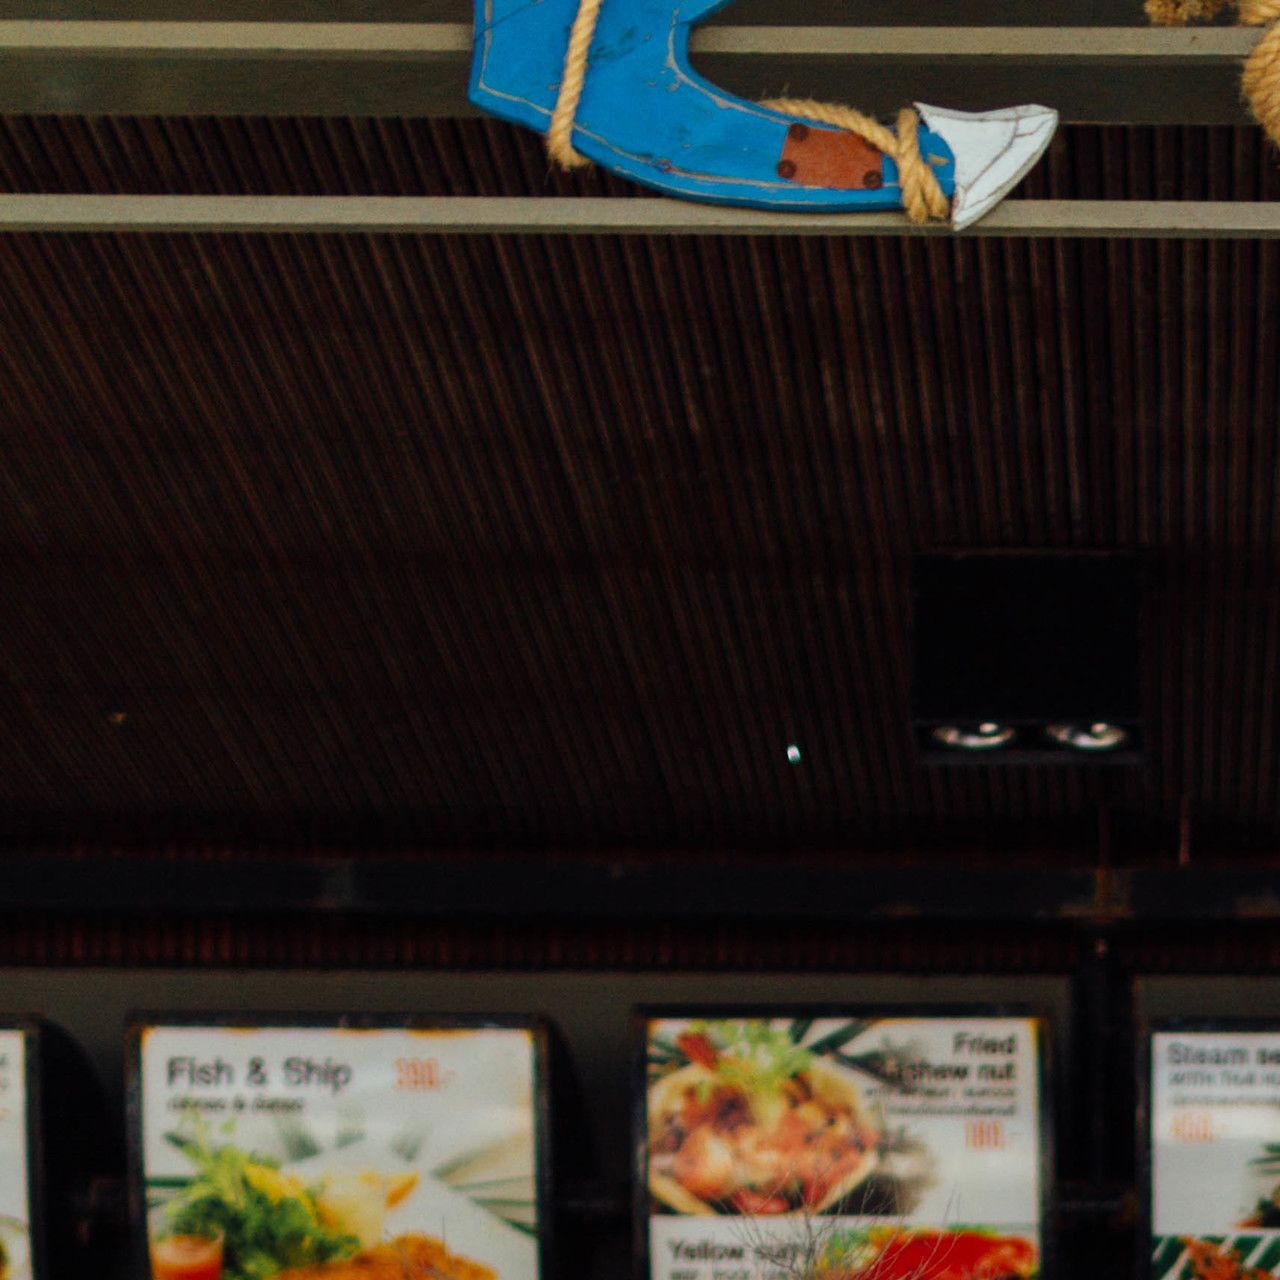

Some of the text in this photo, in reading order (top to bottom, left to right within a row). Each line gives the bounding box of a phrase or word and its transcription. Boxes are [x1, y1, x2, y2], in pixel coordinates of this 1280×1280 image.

[953, 1032, 1018, 1054] Fried
[1168, 1041, 1248, 1065] Steam
[167, 1056, 353, 1094] Fish & Ship
[976, 1060, 1017, 1081] nut
[668, 1240, 744, 1260] Yellow
